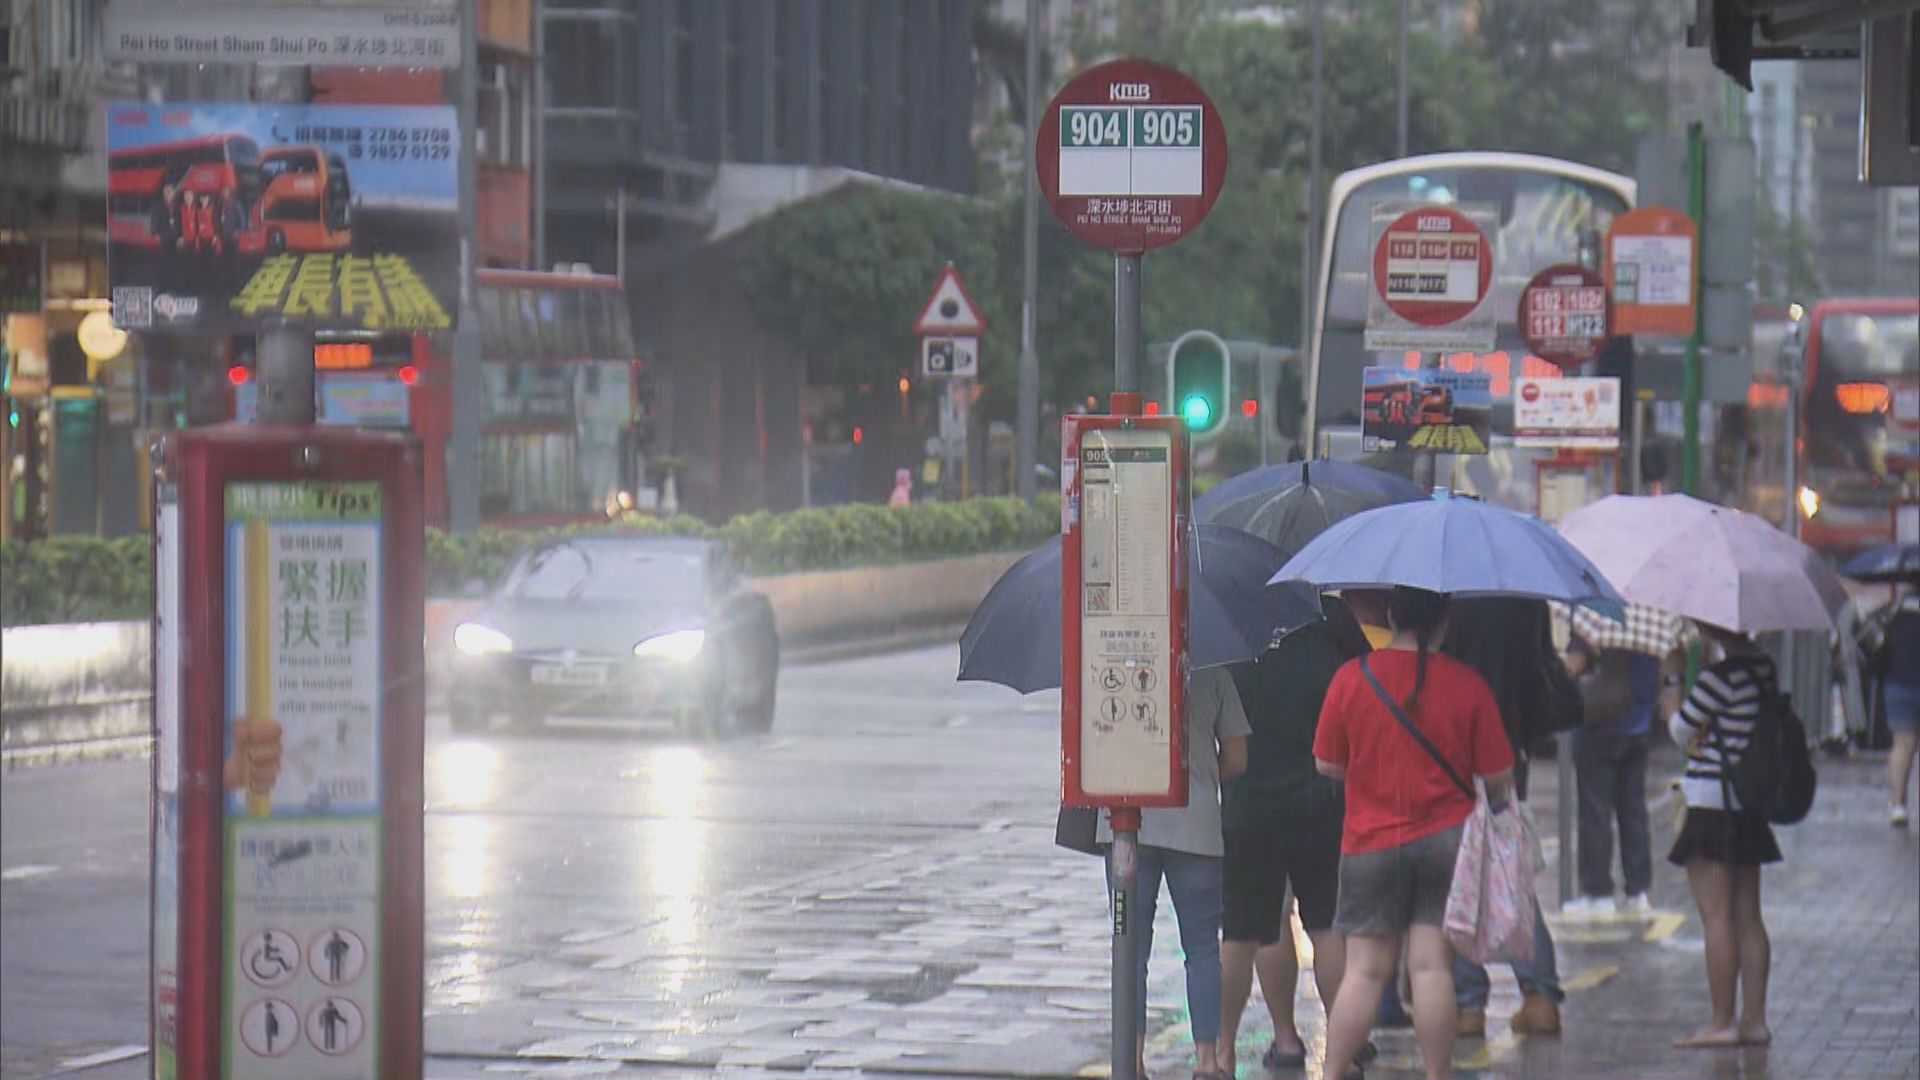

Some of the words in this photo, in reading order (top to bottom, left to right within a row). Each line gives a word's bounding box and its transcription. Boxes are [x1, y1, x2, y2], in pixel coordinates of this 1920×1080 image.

[120, 34, 144, 50] Pei
[148, 35, 169, 50] Ho
[174, 35, 218, 51] Street
[223, 36, 265, 51] Sham
[270, 37, 303, 52] Shui
[307, 37, 328, 53] Po
[1109, 82, 1151, 101] KMB
[1071, 111, 1120, 145] 904
[1143, 110, 1193, 145] 905
[411, 144, 450, 160] 0129
[1534, 290, 1562, 311] 102
[1533, 316, 1562, 336] 112
[1407, 424, 1488, 454] 車長有
[278, 558, 368, 602] 緊握
[278, 604, 368, 649] 扶手
